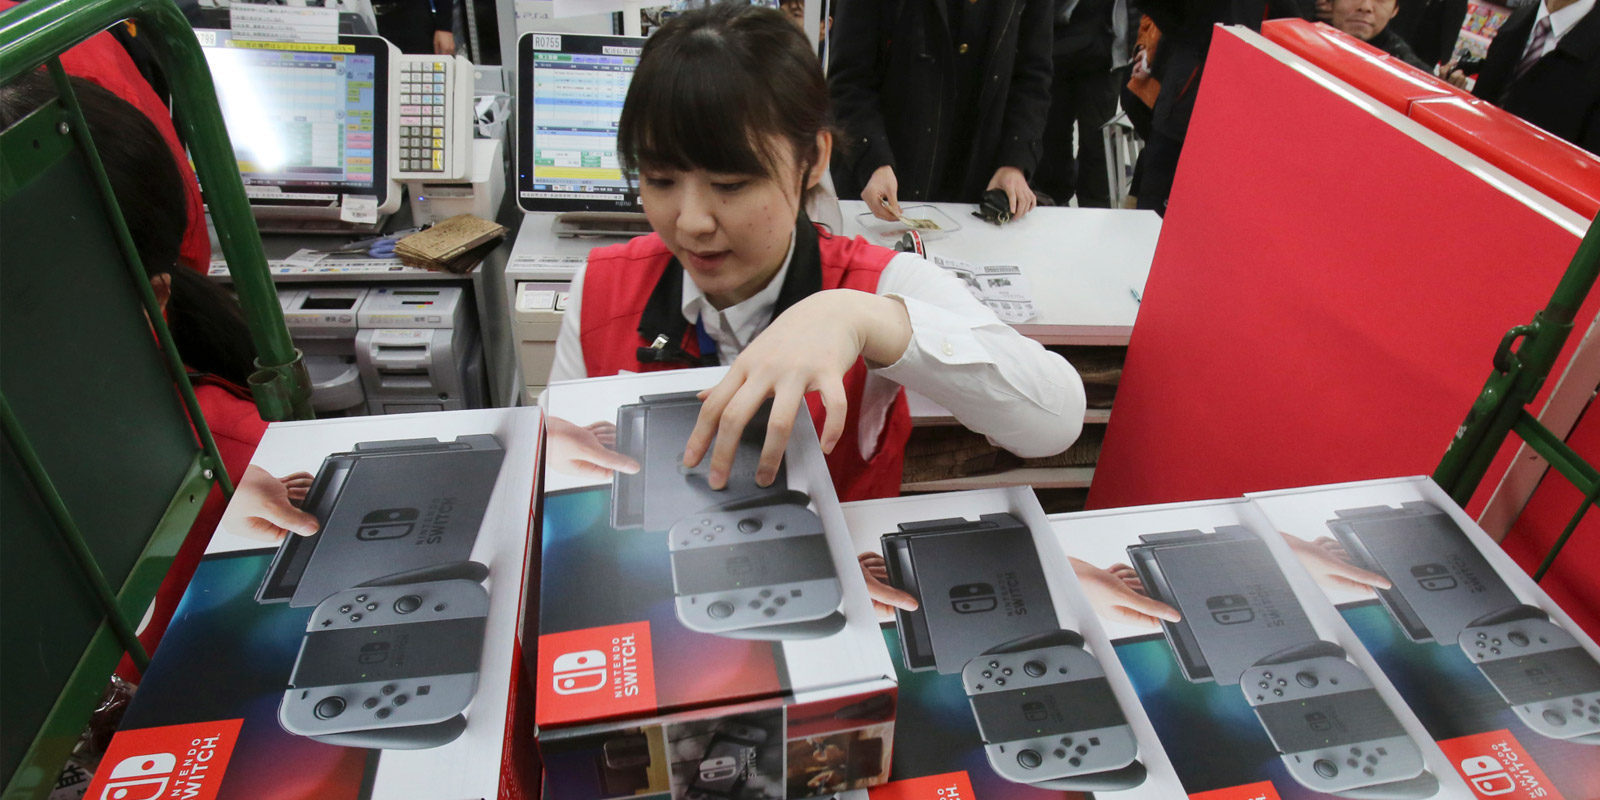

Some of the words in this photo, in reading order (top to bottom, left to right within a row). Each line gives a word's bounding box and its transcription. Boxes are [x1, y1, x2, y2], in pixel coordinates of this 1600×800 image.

[535, 36, 560, 48] R0755
[427, 497, 456, 544] SWITCH
[1006, 572, 1027, 616] SWITCH
[612, 637, 623, 698] NINTENDO
[622, 635, 639, 697] SWITCH
[168, 738, 202, 800] NTENDO
[180, 734, 219, 800] WITCH
[1491, 744, 1537, 799] NINTENDO
[1498, 742, 1548, 798] SWITCH
